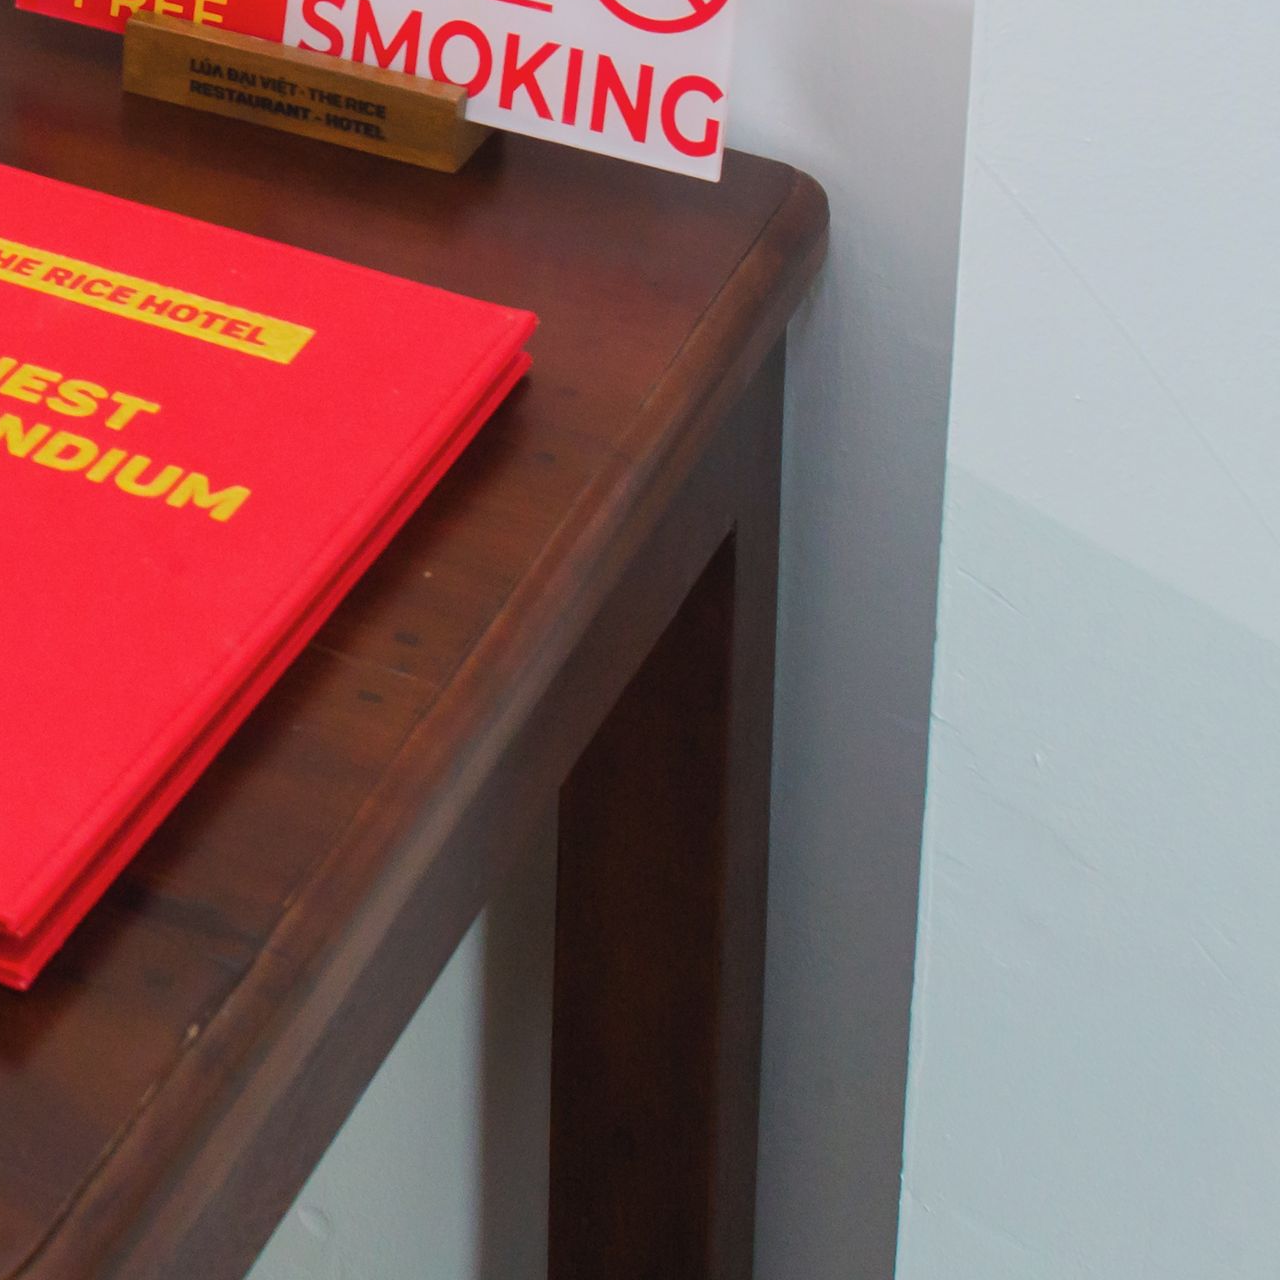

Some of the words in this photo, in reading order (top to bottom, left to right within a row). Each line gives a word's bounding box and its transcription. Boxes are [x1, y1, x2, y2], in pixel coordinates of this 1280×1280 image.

[189, 79, 311, 120] RESTAURANT
[325, 113, 386, 141] HOTEL
[308, 87, 342, 109] THE
[345, 97, 386, 119] RICE
[40, 265, 138, 307] RICE
[137, 294, 272, 347] HOTEL
